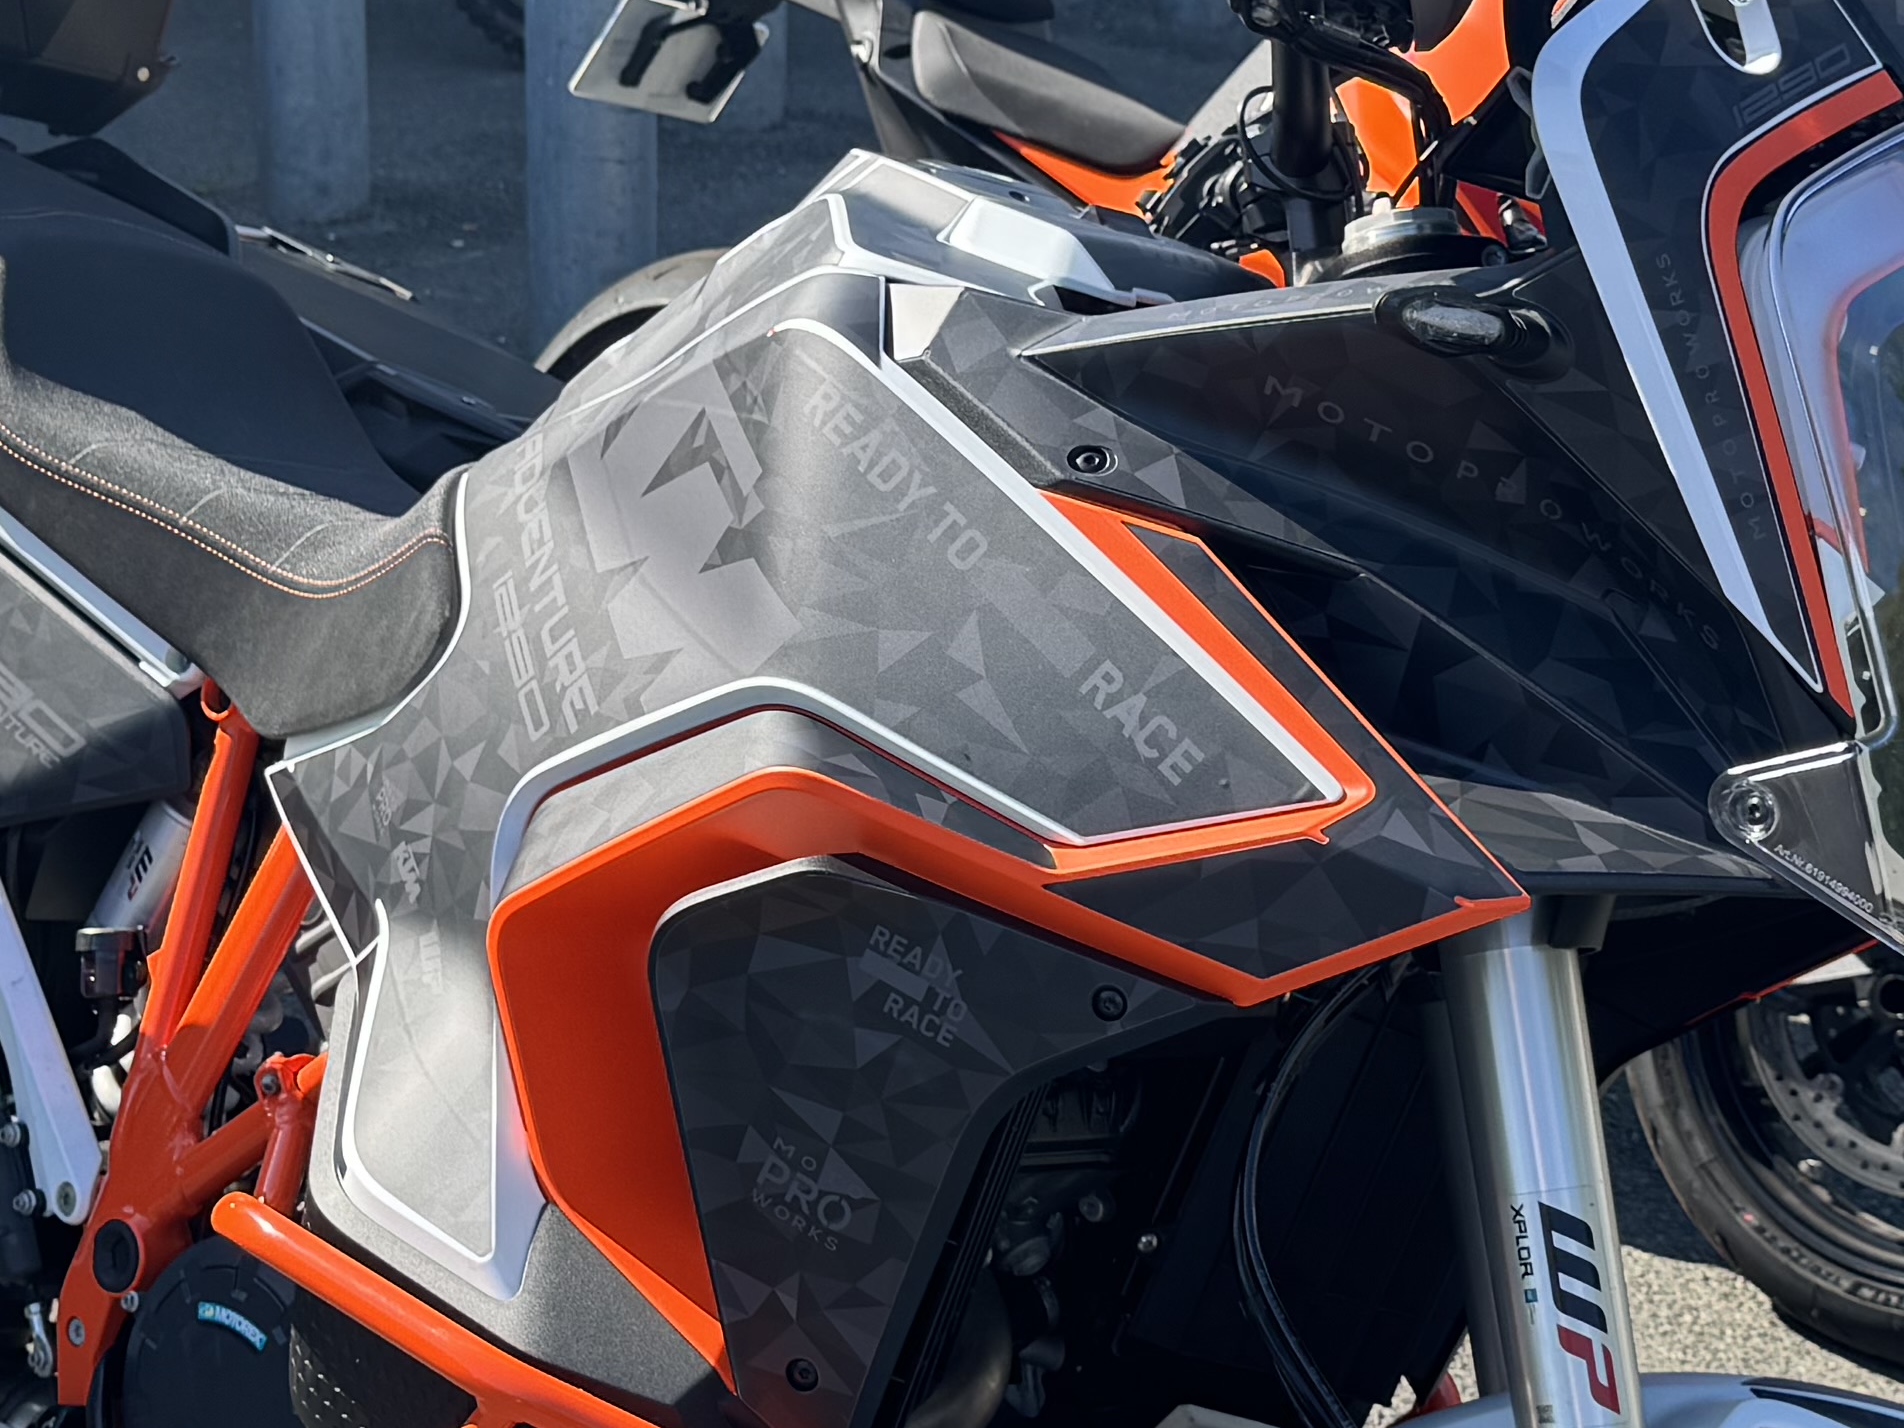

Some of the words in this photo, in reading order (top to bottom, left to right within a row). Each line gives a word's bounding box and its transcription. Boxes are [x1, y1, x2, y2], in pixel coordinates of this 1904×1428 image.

[512, 432, 599, 735] ADVENTURE
[803, 380, 937, 512] READY
[927, 501, 989, 571] TO
[1079, 659, 1205, 787] RACE
[869, 923, 964, 988] READY
[882, 991, 958, 1048] RACE
[932, 989, 969, 1023] TO
[752, 1188, 839, 1251] WORKS
[756, 1154, 853, 1232] PRO
[1510, 1203, 1535, 1281] XPLOR
[1538, 1200, 1621, 1416] WP
